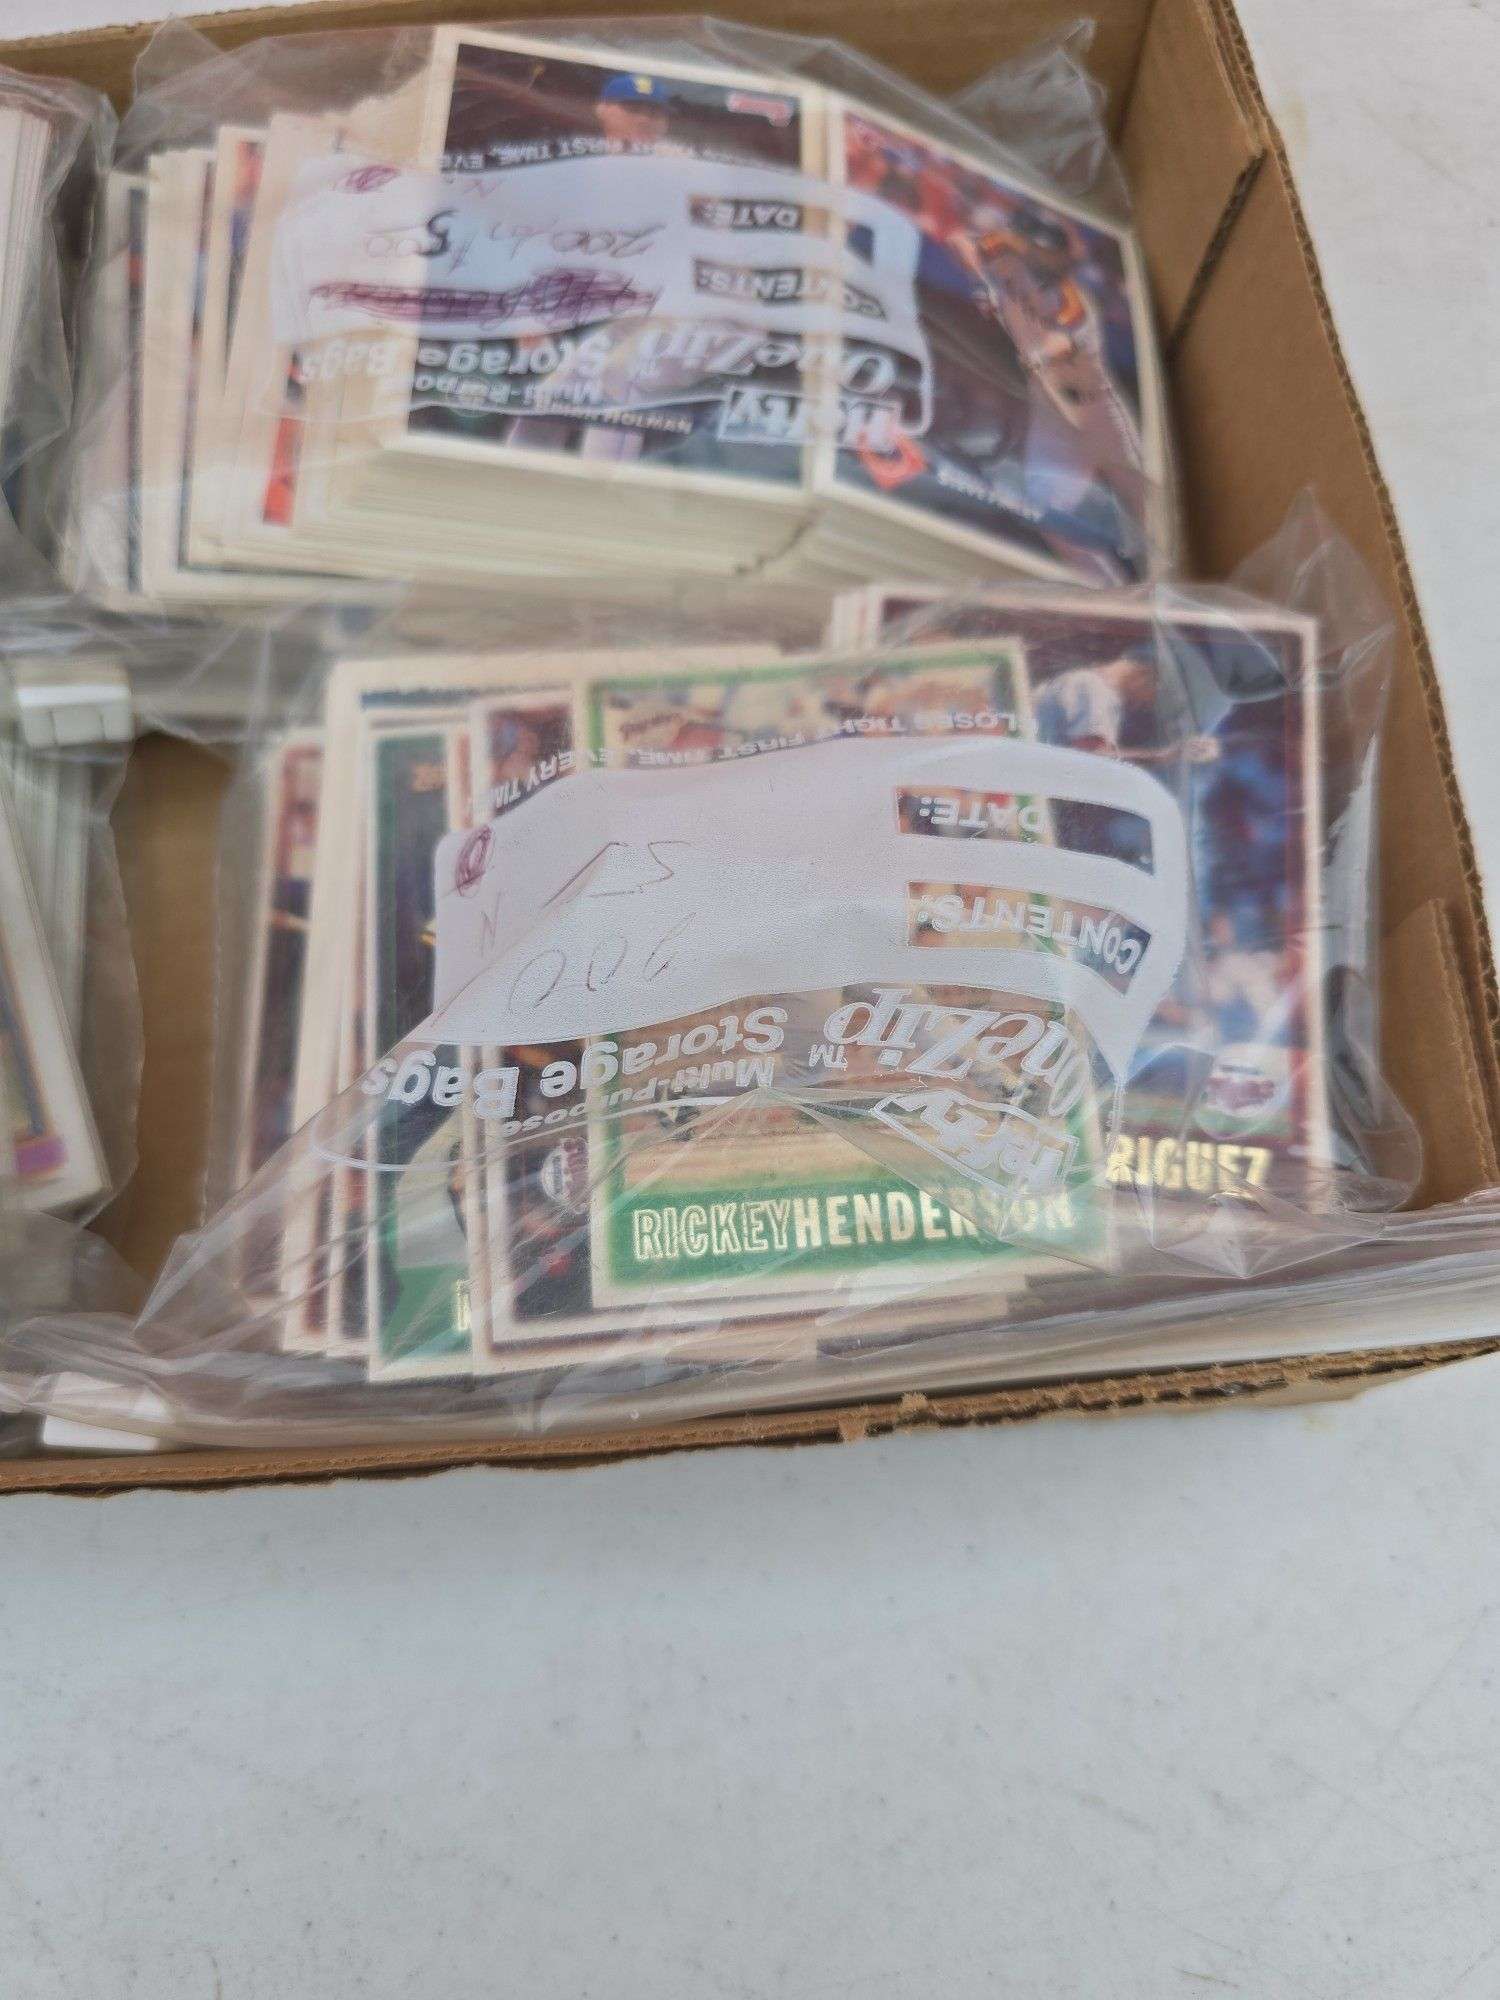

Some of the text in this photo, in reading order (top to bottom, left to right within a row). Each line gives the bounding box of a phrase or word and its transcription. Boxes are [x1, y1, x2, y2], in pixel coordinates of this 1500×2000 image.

[919, 795, 1046, 834] DATE:
[918, 895, 1144, 977] CONTENTS:
[360, 1006, 789, 1121] Storage Bags
[501, 1055, 776, 1138] Multi-Purpose
